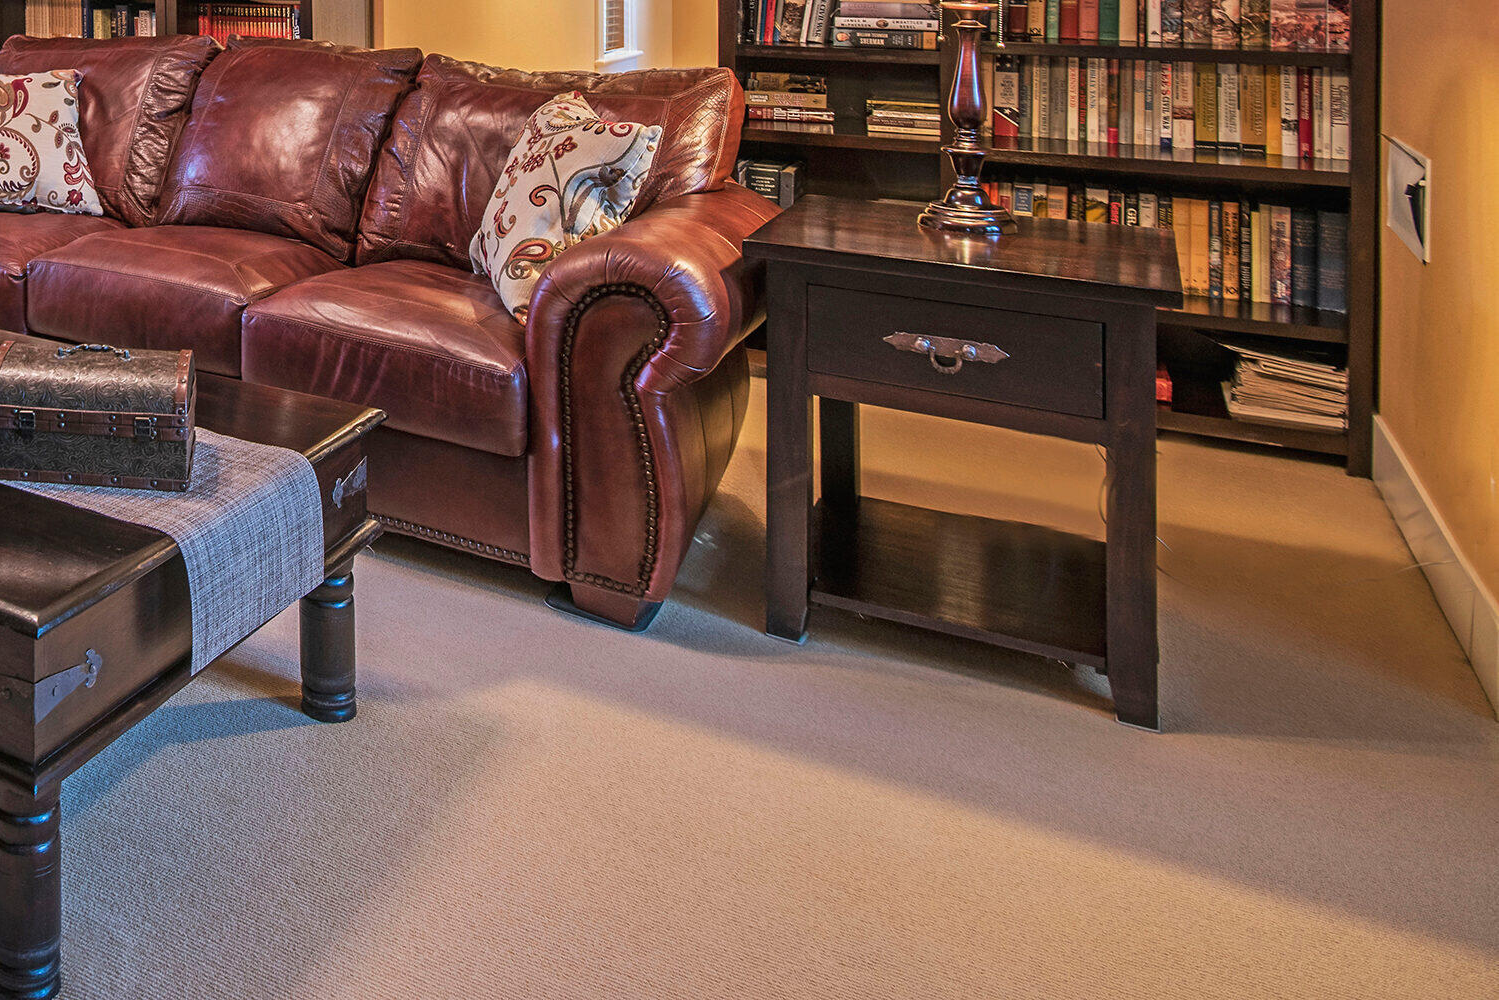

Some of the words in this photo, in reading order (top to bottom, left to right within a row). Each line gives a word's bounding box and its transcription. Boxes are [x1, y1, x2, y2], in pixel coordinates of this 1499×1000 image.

[818, 4, 827, 21] CIVIL
[815, 21, 824, 38] WAR
[1162, 96, 1170, 114] CIVIL
[1162, 115, 1170, 130] WAR
[1224, 227, 1232, 256] Coffee
